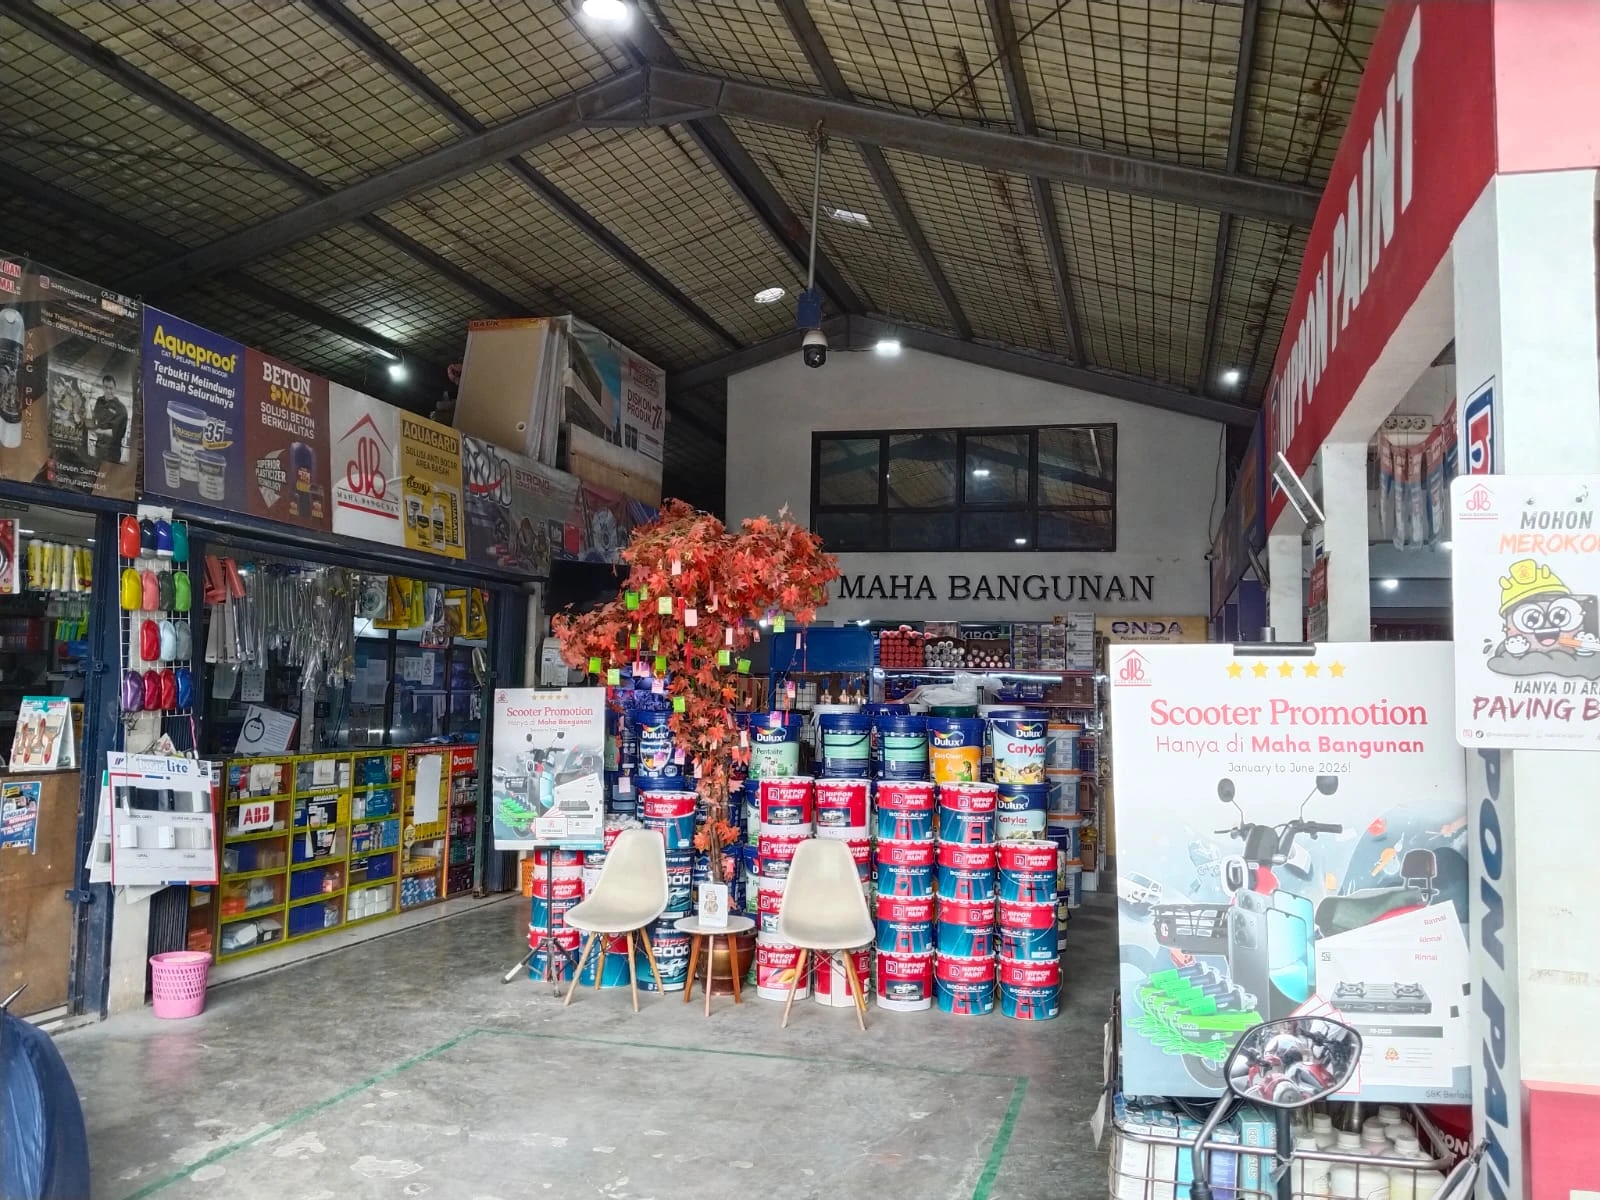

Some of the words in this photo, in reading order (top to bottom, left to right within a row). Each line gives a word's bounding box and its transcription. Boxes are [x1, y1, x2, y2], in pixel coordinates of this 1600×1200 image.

[1279, 252, 1329, 456] NIPPON
[1332, 4, 1421, 352] PAINT
[26, 331, 34, 374] YANG
[154, 325, 236, 374] Aquaproof
[154, 360, 190, 381] Terbukti
[191, 373, 236, 399] Melindungi
[263, 361, 311, 396] BETON
[156, 373, 186, 393] Rumah
[187, 384, 234, 409] Seluruhnya
[628, 388, 651, 413] DISKON
[24, 386, 33, 439] PUNYA
[281, 388, 311, 416] MIX
[260, 401, 289, 419] SOLUSI
[290, 411, 315, 429] BETON
[627, 402, 651, 425] PRODUK
[206, 422, 224, 442] 35
[261, 413, 315, 440] BERKUALITAS
[404, 420, 457, 454] AQUAGARD
[406, 446, 426, 458] SOLUSI
[427, 450, 440, 462] ANTI
[416, 459, 430, 470] AREA
[1520, 511, 1594, 530] MOHON
[1498, 533, 1600, 556] MEROKO
[837, 575, 937, 600] MAHA
[948, 575, 1155, 601] BANGUNAN
[1112, 621, 1184, 635] ONDA
[1514, 681, 1558, 694] HANYA
[1563, 681, 1577, 694] DI
[507, 707, 541, 717] Scooter
[544, 706, 593, 716] Promotion
[1150, 699, 1262, 726] Scooter
[1269, 699, 1428, 726] Promotion
[1473, 696, 1577, 722] PAVING
[642, 731, 668, 739] Dulux
[756, 734, 783, 742] Dulux
[934, 738, 961, 746] Dulux
[1016, 730, 1041, 738] Dulux
[1156, 736, 1220, 758] Hanya
[1227, 733, 1244, 753] di
[1251, 736, 1311, 753] Maha
[1318, 736, 1424, 758] Bangunan
[167, 760, 189, 773] lite
[1228, 763, 1272, 776] January
[1275, 764, 1287, 774] to
[1289, 763, 1315, 774] June
[1319, 762, 1352, 774] 2026!
[243, 806, 270, 825] ABB
[998, 802, 1025, 810] Dulux
[999, 815, 1027, 825] Catylac
[652, 946, 689, 957] 2000
[770, 957, 793, 965] PAINT
